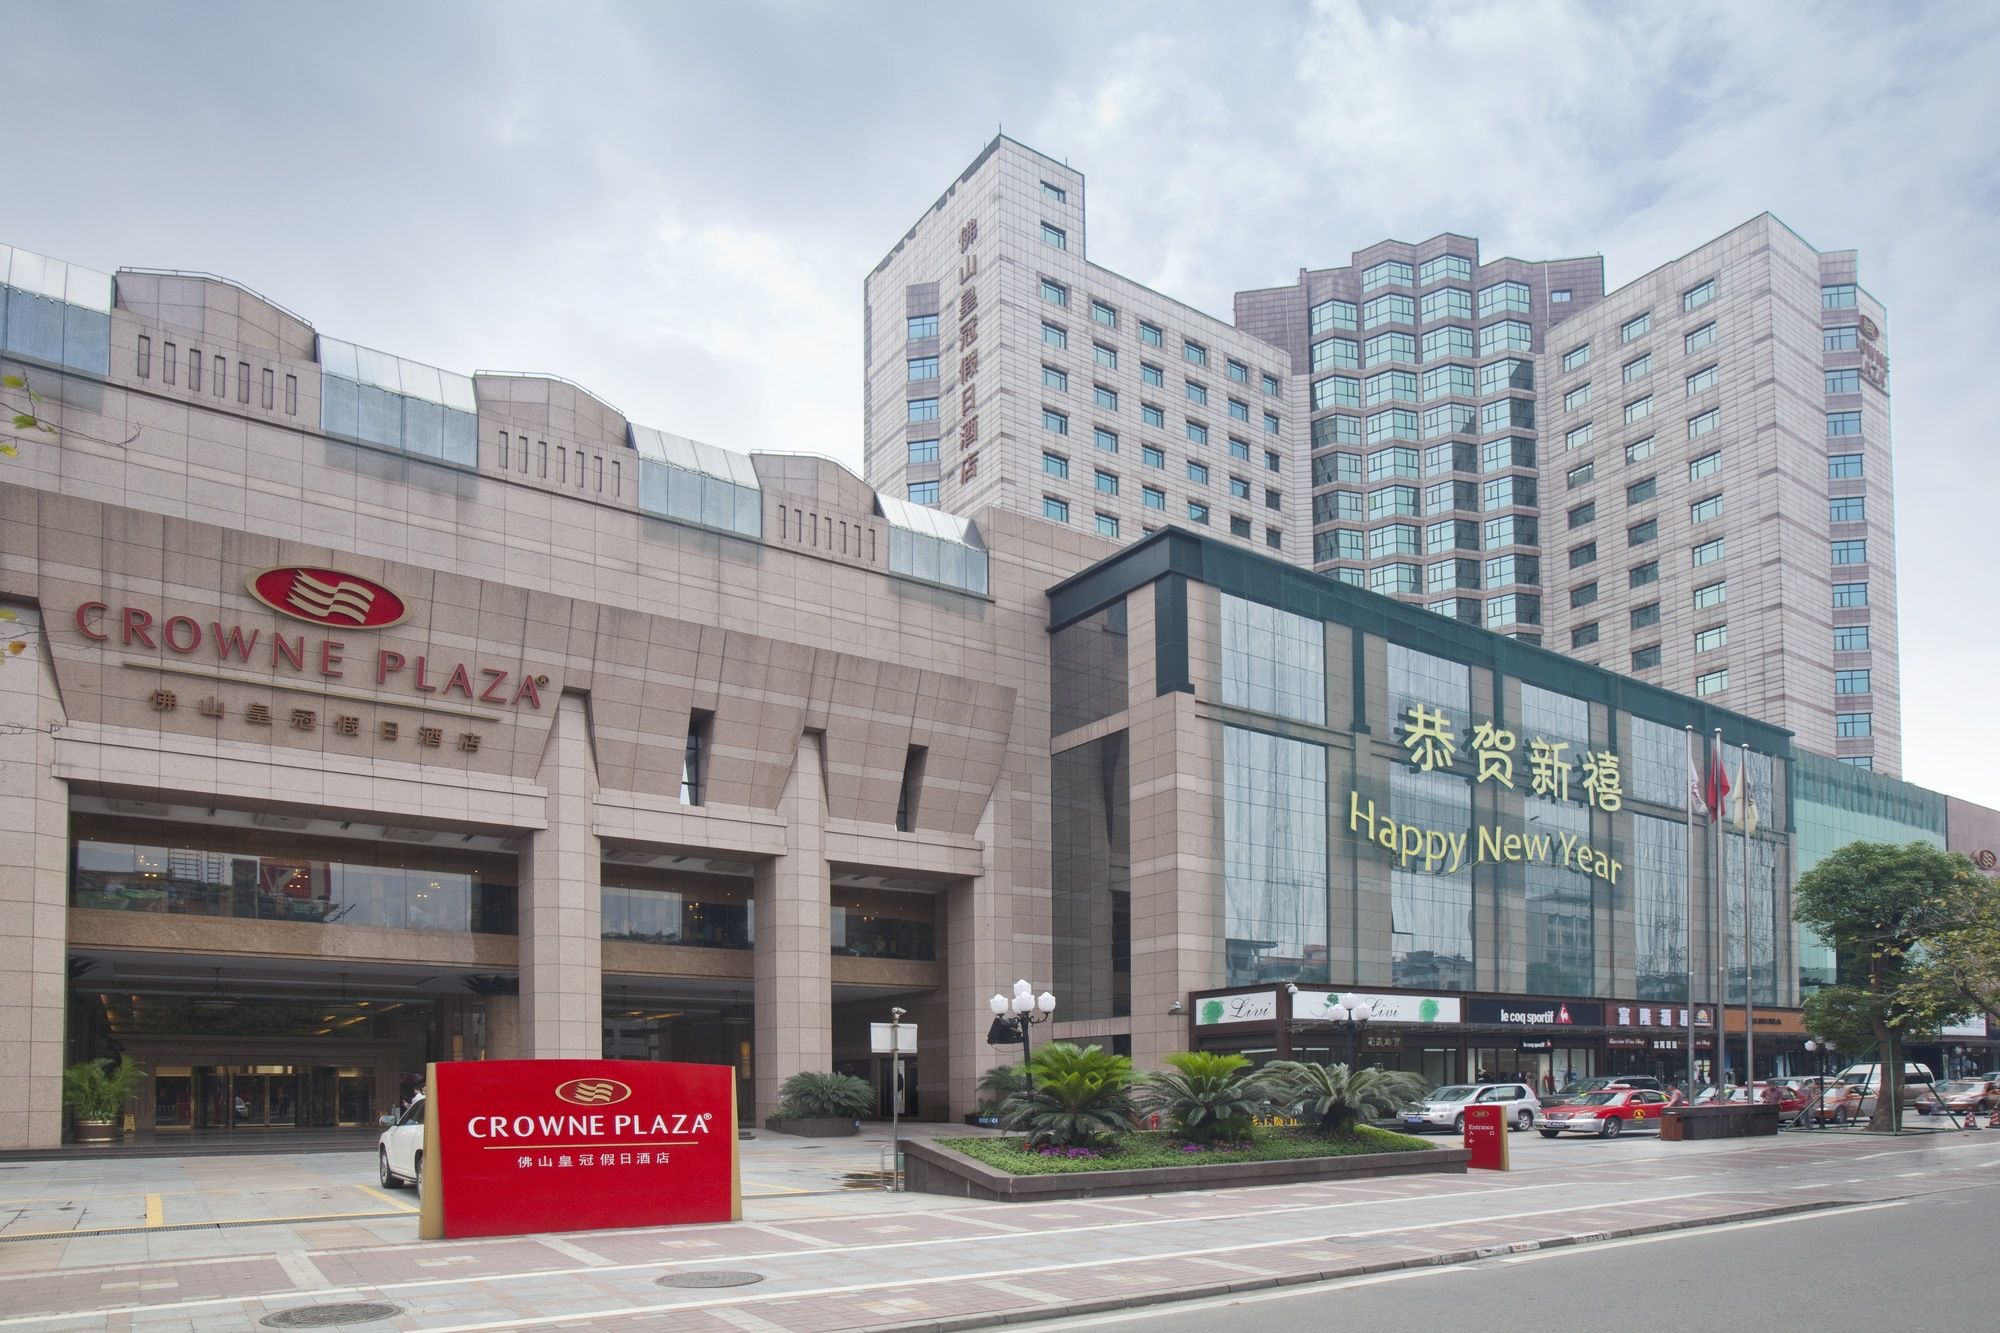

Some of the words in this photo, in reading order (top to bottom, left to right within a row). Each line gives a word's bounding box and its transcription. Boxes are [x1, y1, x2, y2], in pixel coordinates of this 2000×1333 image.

[958, 218, 979, 485] 佛山皇冠假日酒店
[75, 600, 346, 677] CROWNE
[377, 649, 550, 709] PLAZA®
[150, 687, 482, 754] 佛山皇冠假日酒店
[1403, 703, 1623, 812] 恭贺新禧
[1349, 790, 1467, 873] Happy
[1477, 824, 1551, 863] New
[1559, 830, 1623, 886] Year
[1230, 997, 1272, 1020] Livi
[1364, 996, 1400, 1019] Livi
[1501, 1009, 1509, 1022] le
[1509, 1012, 1526, 1024] coq
[1526, 1010, 1554, 1025] sportif
[467, 1115, 605, 1139] CROWNE
[614, 1111, 713, 1136] PLAZA®
[517, 1152, 671, 1169] 佛山皇冠假日酒店
